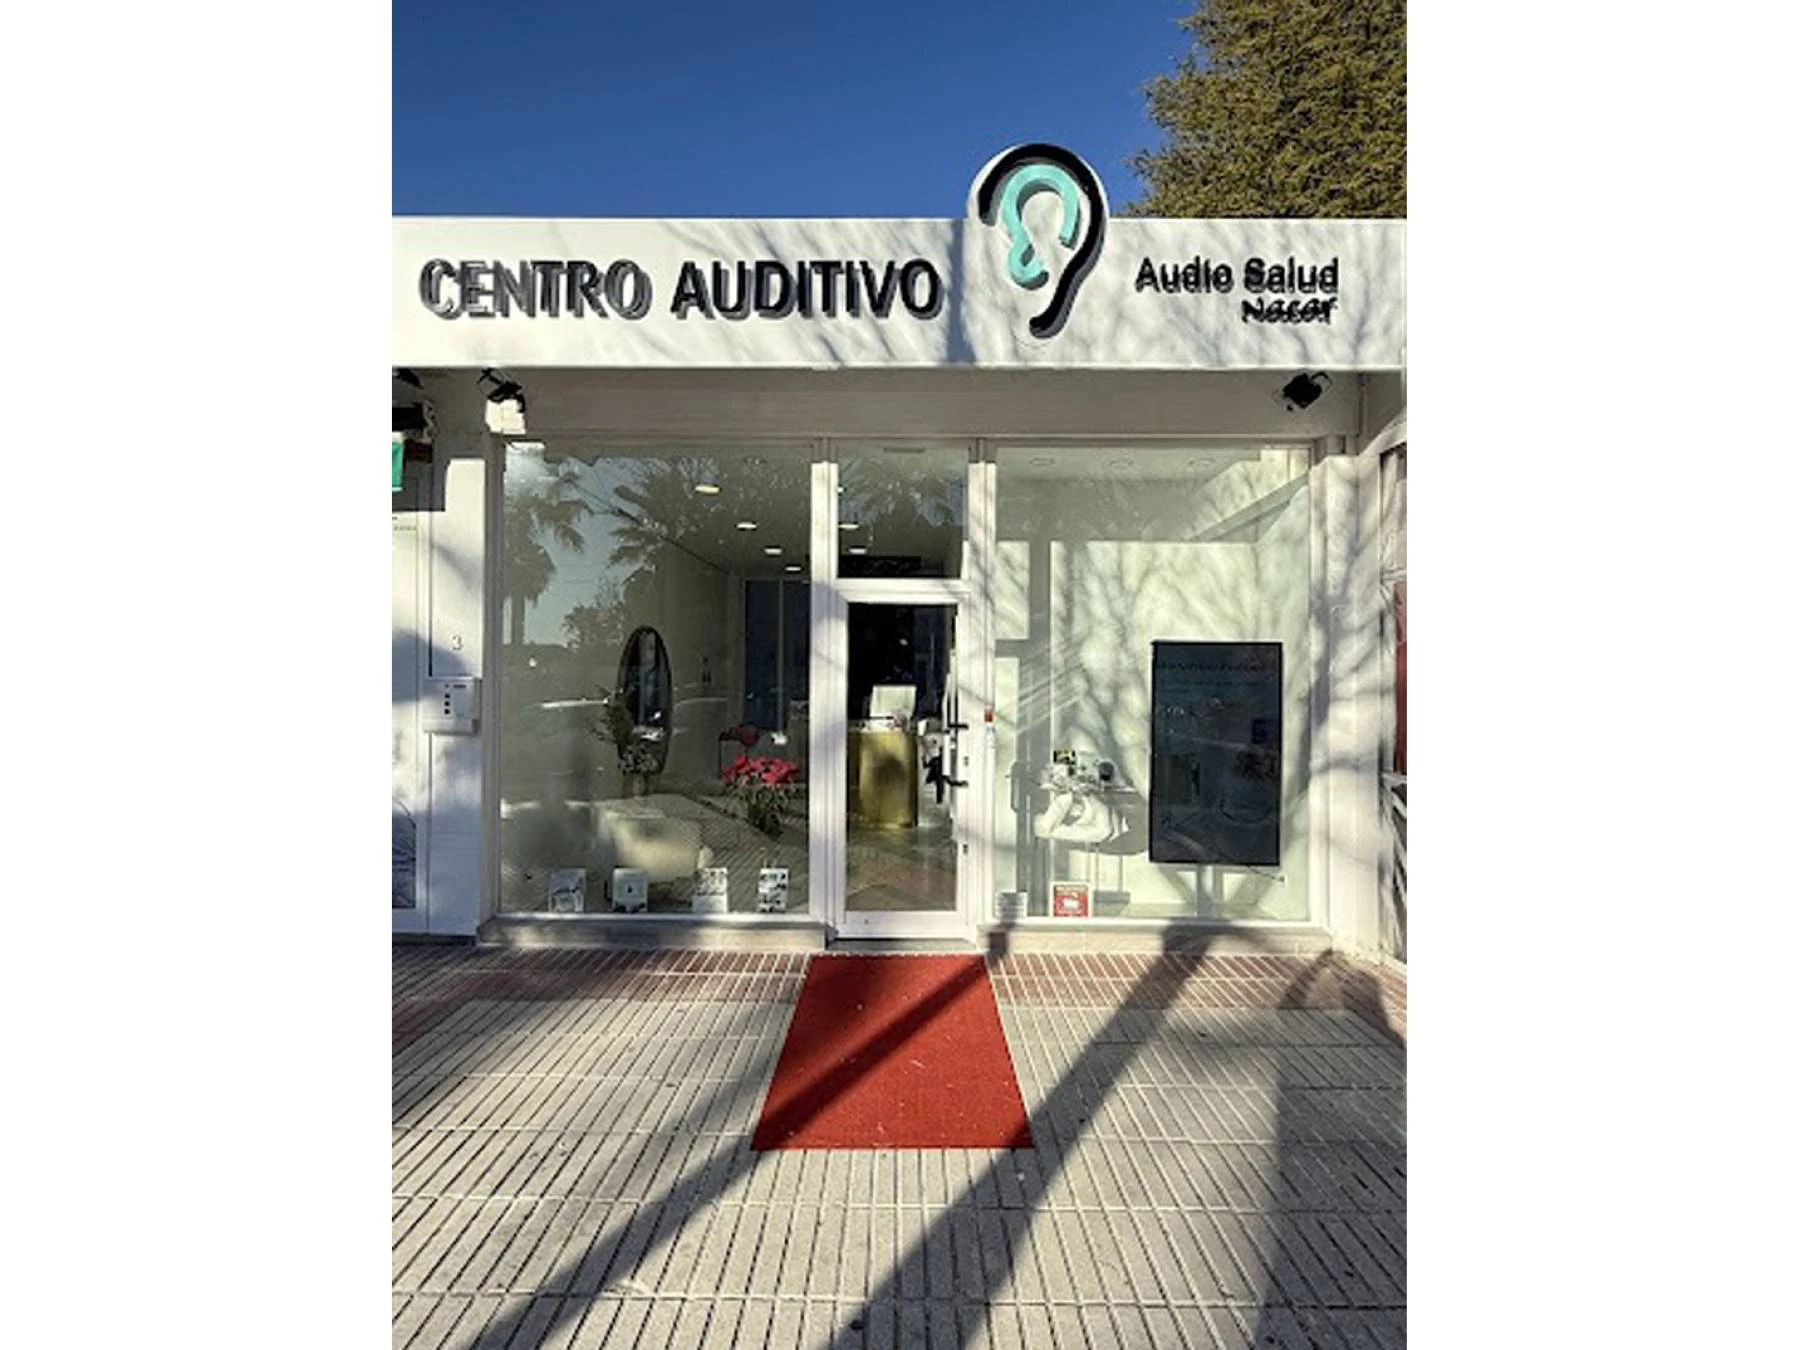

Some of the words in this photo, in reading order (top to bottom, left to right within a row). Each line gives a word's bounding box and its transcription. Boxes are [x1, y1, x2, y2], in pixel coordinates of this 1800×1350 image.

[418, 259, 653, 319] CENTRO
[671, 259, 943, 319] AUDITIVO
[1135, 256, 1235, 294] Audio
[1243, 256, 1339, 294] Salud
